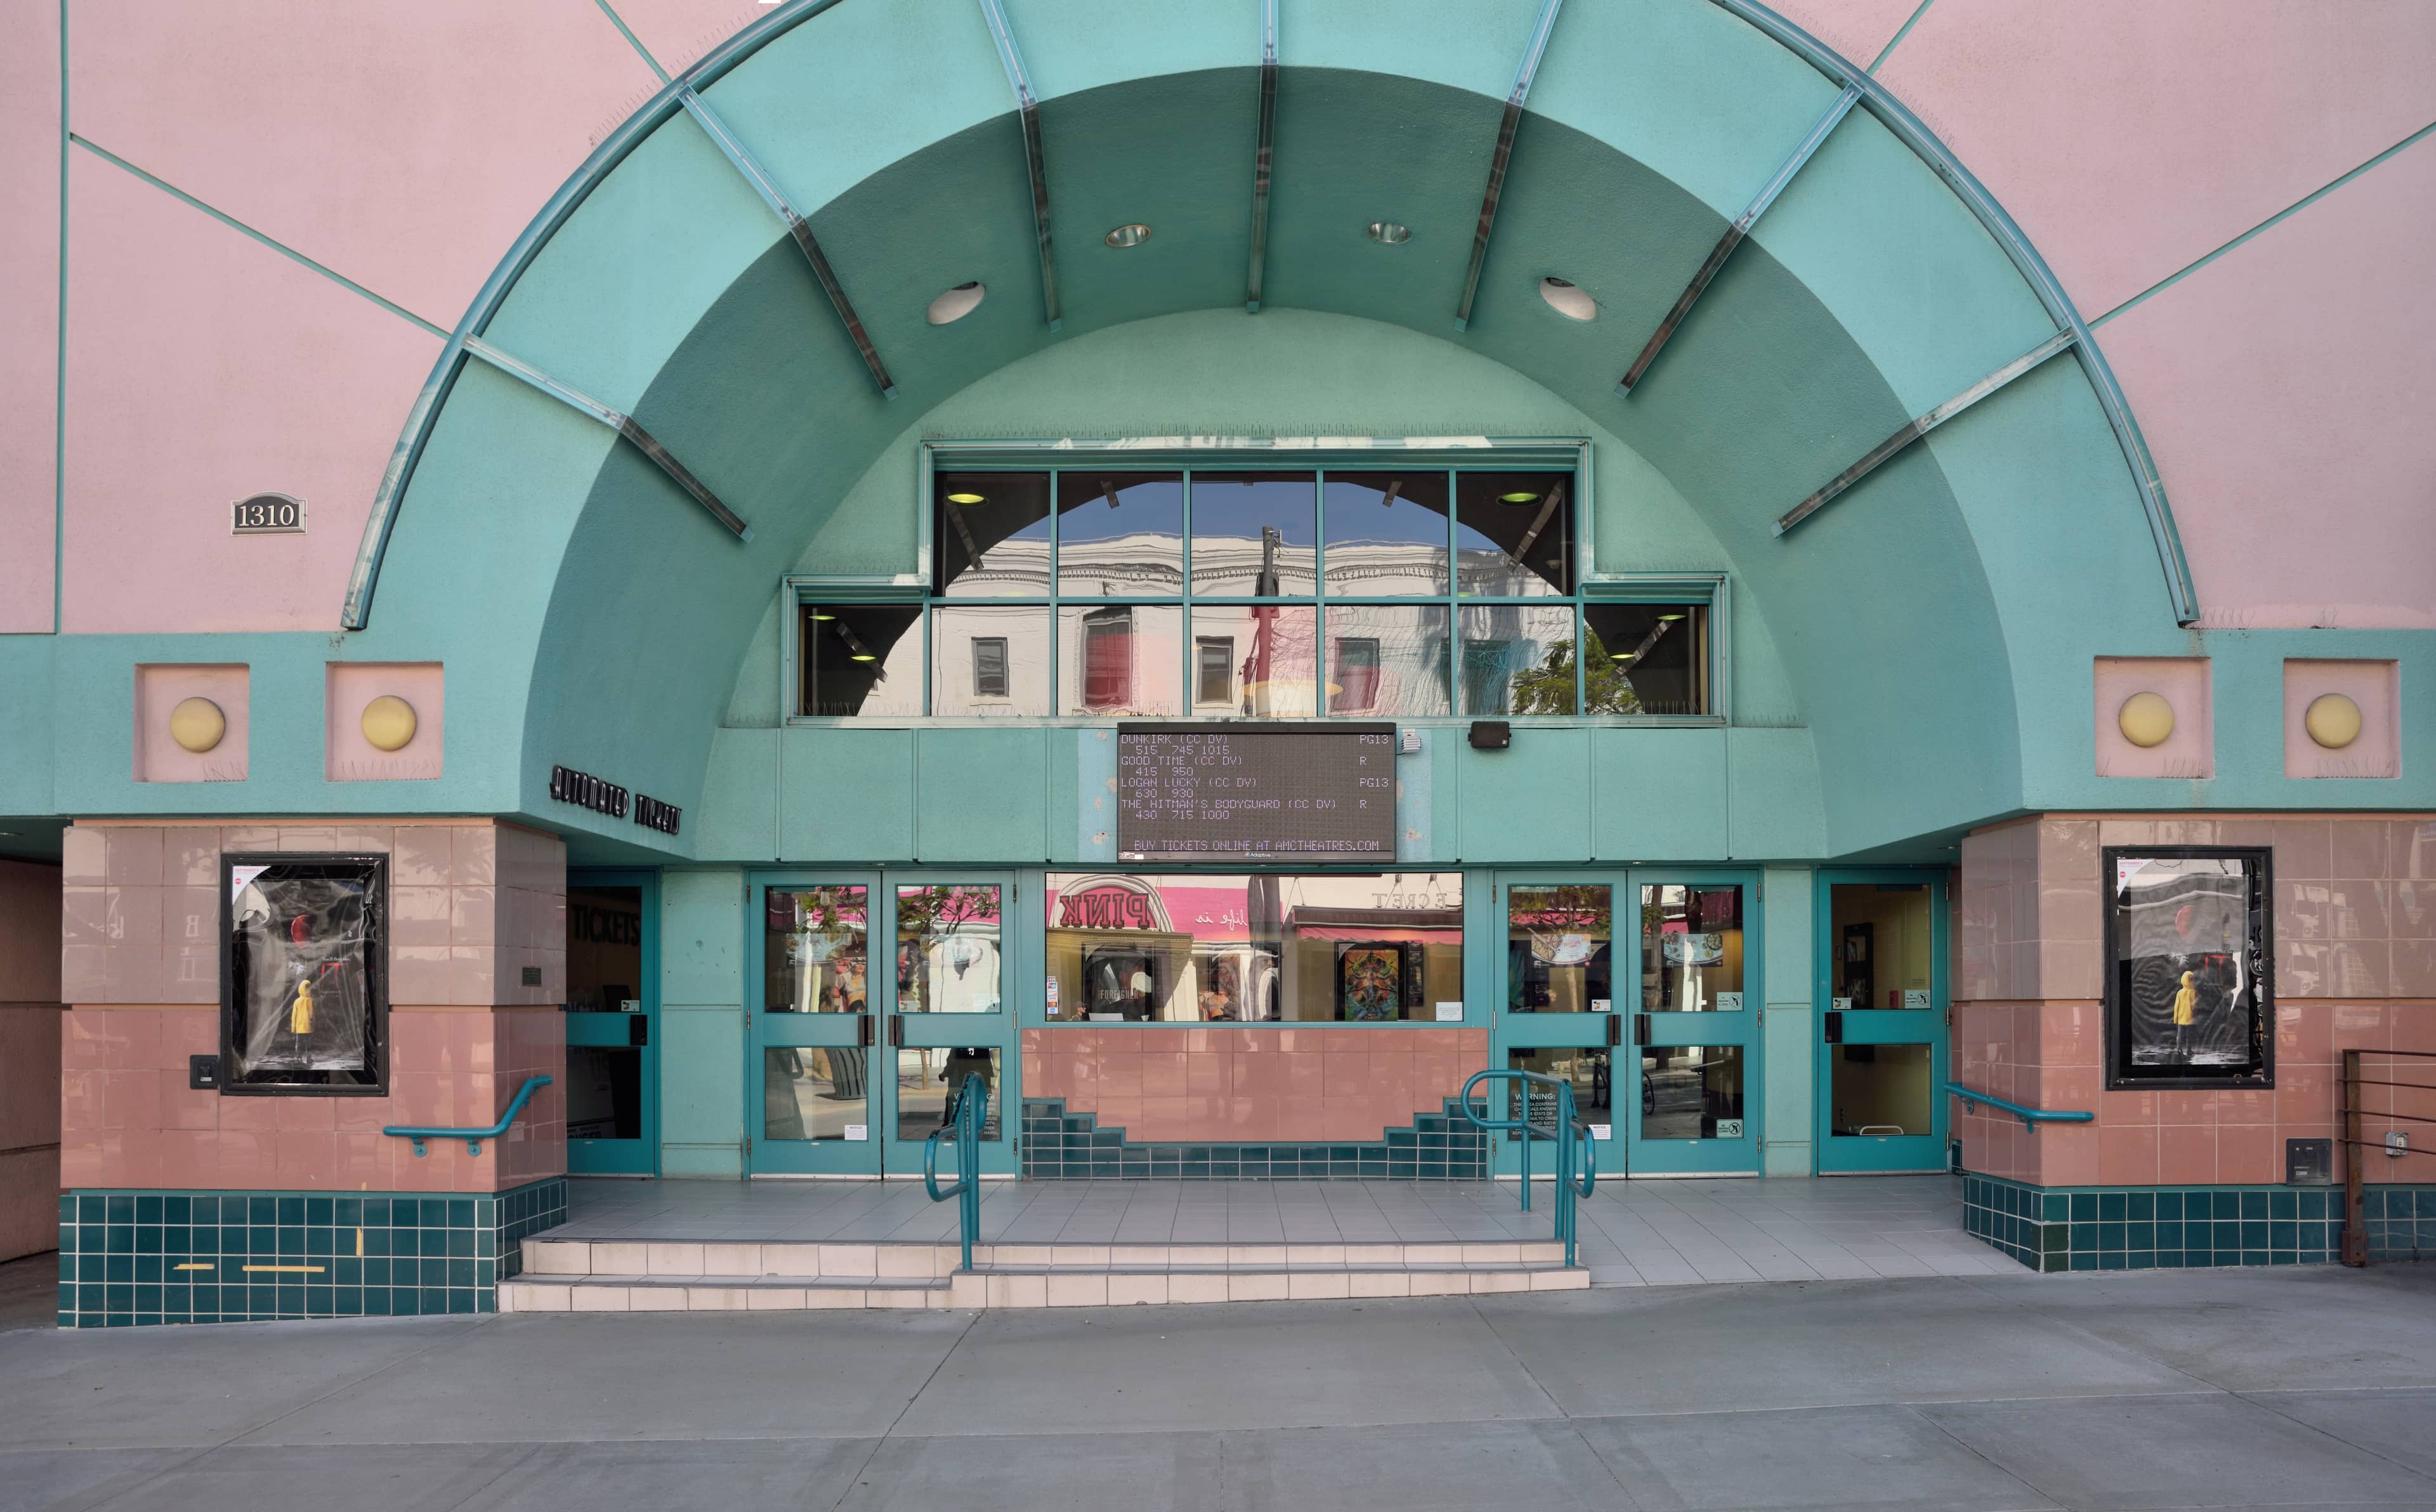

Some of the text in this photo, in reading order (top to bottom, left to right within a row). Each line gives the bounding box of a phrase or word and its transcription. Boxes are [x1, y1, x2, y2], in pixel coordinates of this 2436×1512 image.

[239, 505, 294, 526] 1310
[1121, 734, 1228, 744] DUNKIRK (CC DV)
[1359, 734, 1389, 744] PG13
[1136, 745, 1229, 755] 515 745 1015
[1121, 756, 1241, 766] GOOD TIME (CC DV)
[1359, 756, 1366, 766] R
[1136, 767, 1193, 776] 415 950
[1121, 778, 1256, 787] LOGAN LUCKY (CC DV)
[1359, 778, 1389, 787] PG13
[549, 764, 629, 818] AUTOMATED
[1136, 788, 1193, 798] 630 930
[1121, 799, 1335, 809] THE HITMAN'S BODYGUARD (CC DV)
[1359, 799, 1366, 809] R
[1136, 810, 1229, 819] 430 715 1000
[1134, 840, 1379, 851] BUY TICKETS ONLINE AT AMCTHEATRES.COM
[572, 903, 640, 946] TICKETS
